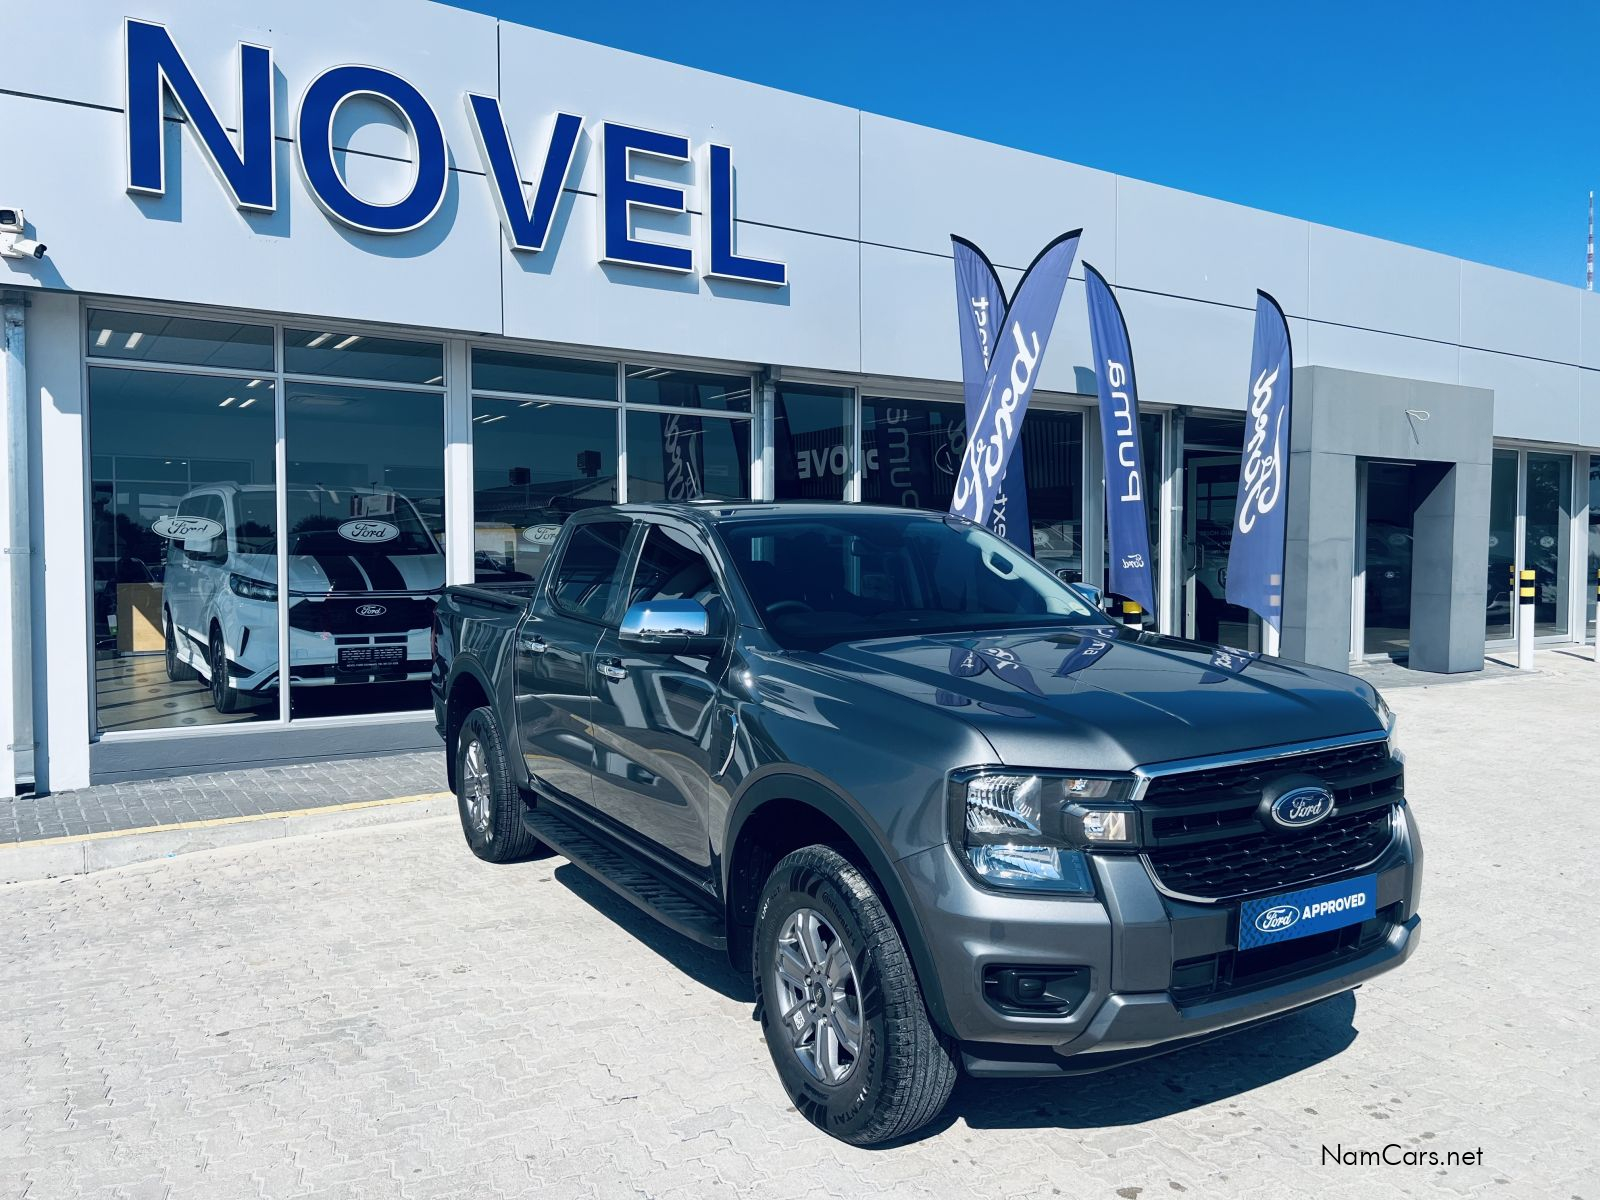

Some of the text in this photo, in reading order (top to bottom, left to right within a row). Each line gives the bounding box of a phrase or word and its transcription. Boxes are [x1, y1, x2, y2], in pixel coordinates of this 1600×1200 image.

[124, 17, 787, 287] NOVEL
[953, 321, 1040, 524] Ford
[351, 523, 387, 538] Ford
[534, 526, 557, 540] For
[360, 605, 382, 615] Ford
[1289, 796, 1324, 820] Ford
[1262, 892, 1367, 930] Ford APPROVED
